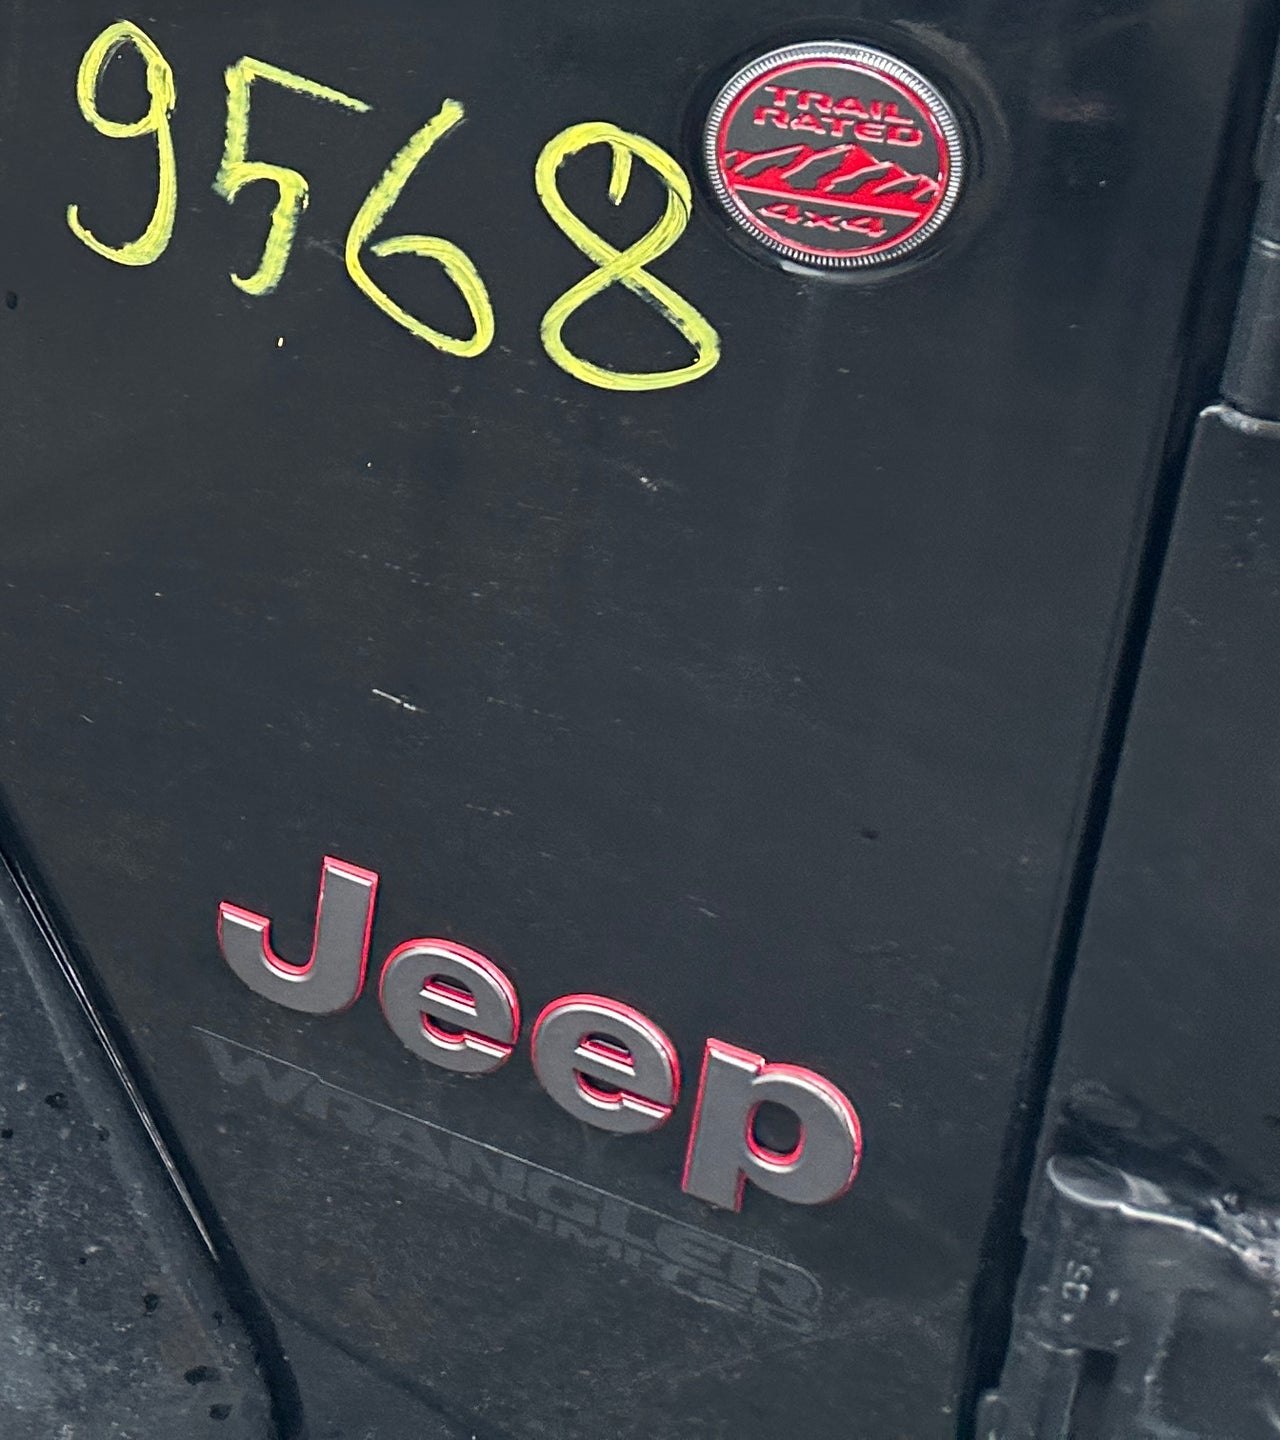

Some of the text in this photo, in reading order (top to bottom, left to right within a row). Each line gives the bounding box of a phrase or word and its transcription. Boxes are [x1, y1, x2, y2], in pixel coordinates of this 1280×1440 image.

[65, 18, 721, 392] 9568
[753, 105, 923, 147] RATED
[764, 84, 914, 125] TRAIL
[196, 1030, 819, 1317] WRANGLER
[216, 854, 863, 1213] Jeep
